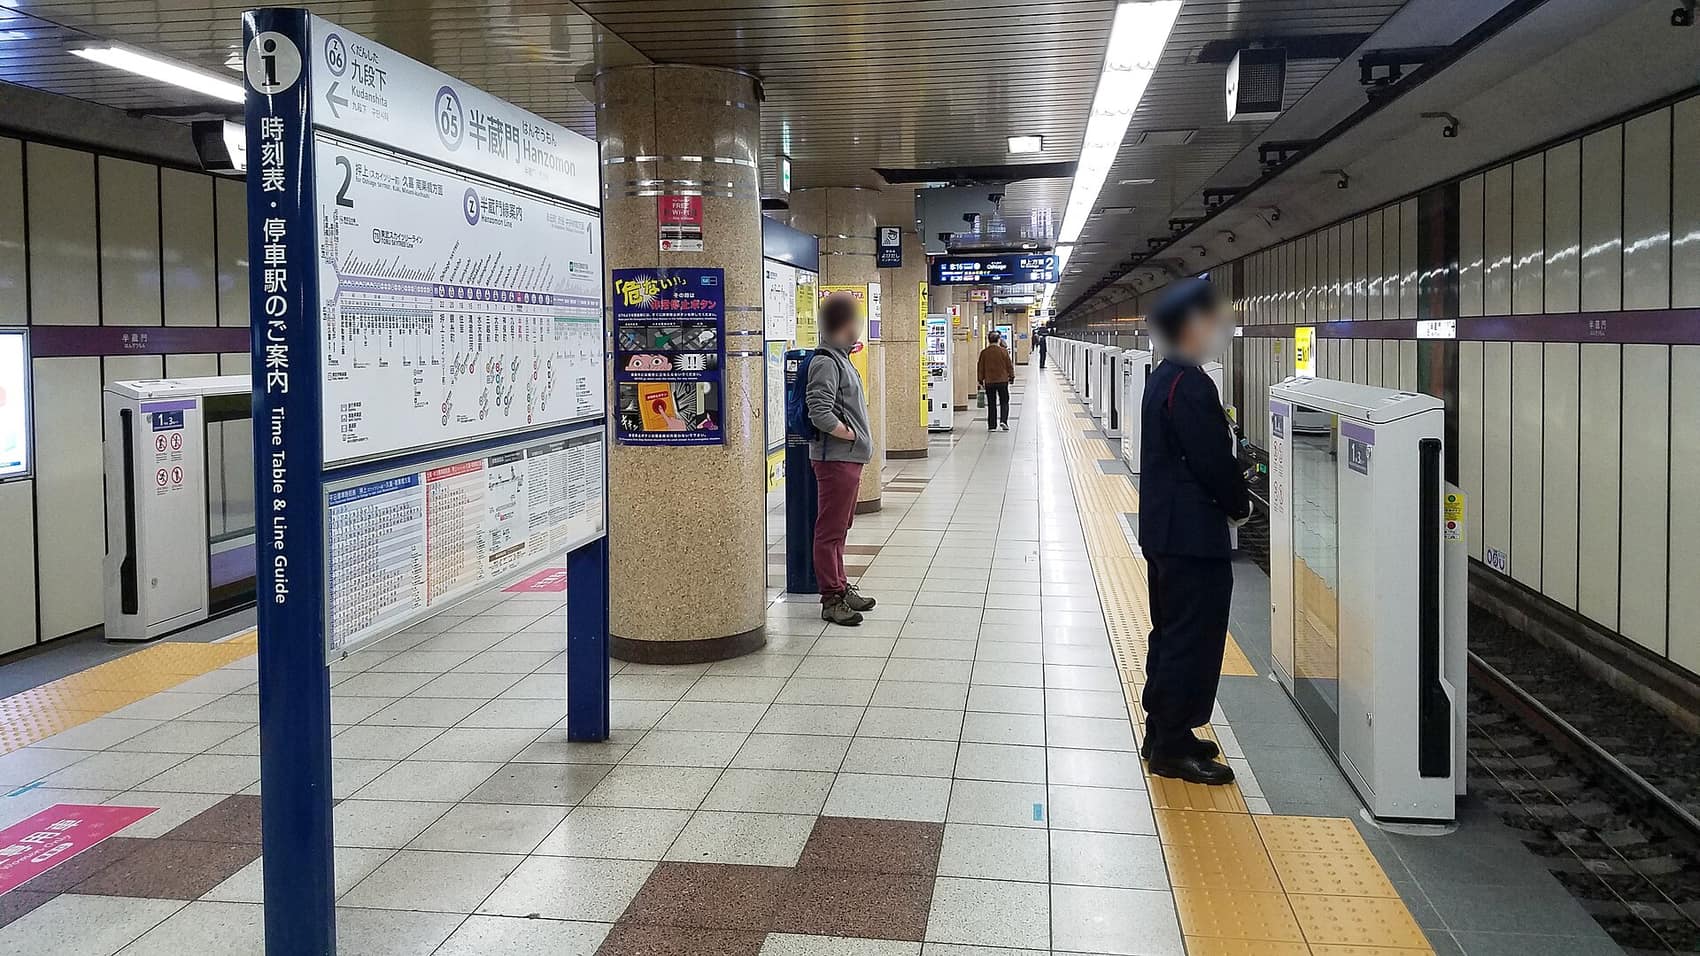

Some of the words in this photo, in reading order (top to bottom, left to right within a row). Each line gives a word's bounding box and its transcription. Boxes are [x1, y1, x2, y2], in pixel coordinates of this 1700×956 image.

[333, 40, 338, 50] Z
[350, 43, 379, 64] くだんした
[329, 50, 343, 68] 06
[352, 59, 387, 91] 九段下
[352, 85, 388, 108] Kudanshita
[446, 97, 452, 111] Z
[441, 111, 458, 138] 05
[469, 109, 521, 164] 半蔵門
[522, 121, 557, 147] はんぞうもん
[523, 138, 576, 177] Hanzomon
[335, 155, 354, 208] 2
[469, 200, 475, 214] Z
[586, 222, 593, 254] 1
[1045, 257, 1054, 270] 2
[650, 299, 717, 311] 非常停止ボタン
[272, 406, 285, 446] Time
[272, 450, 286, 493] Table
[273, 499, 287, 511] &
[273, 517, 287, 550] Line
[274, 555, 288, 604] Guide
